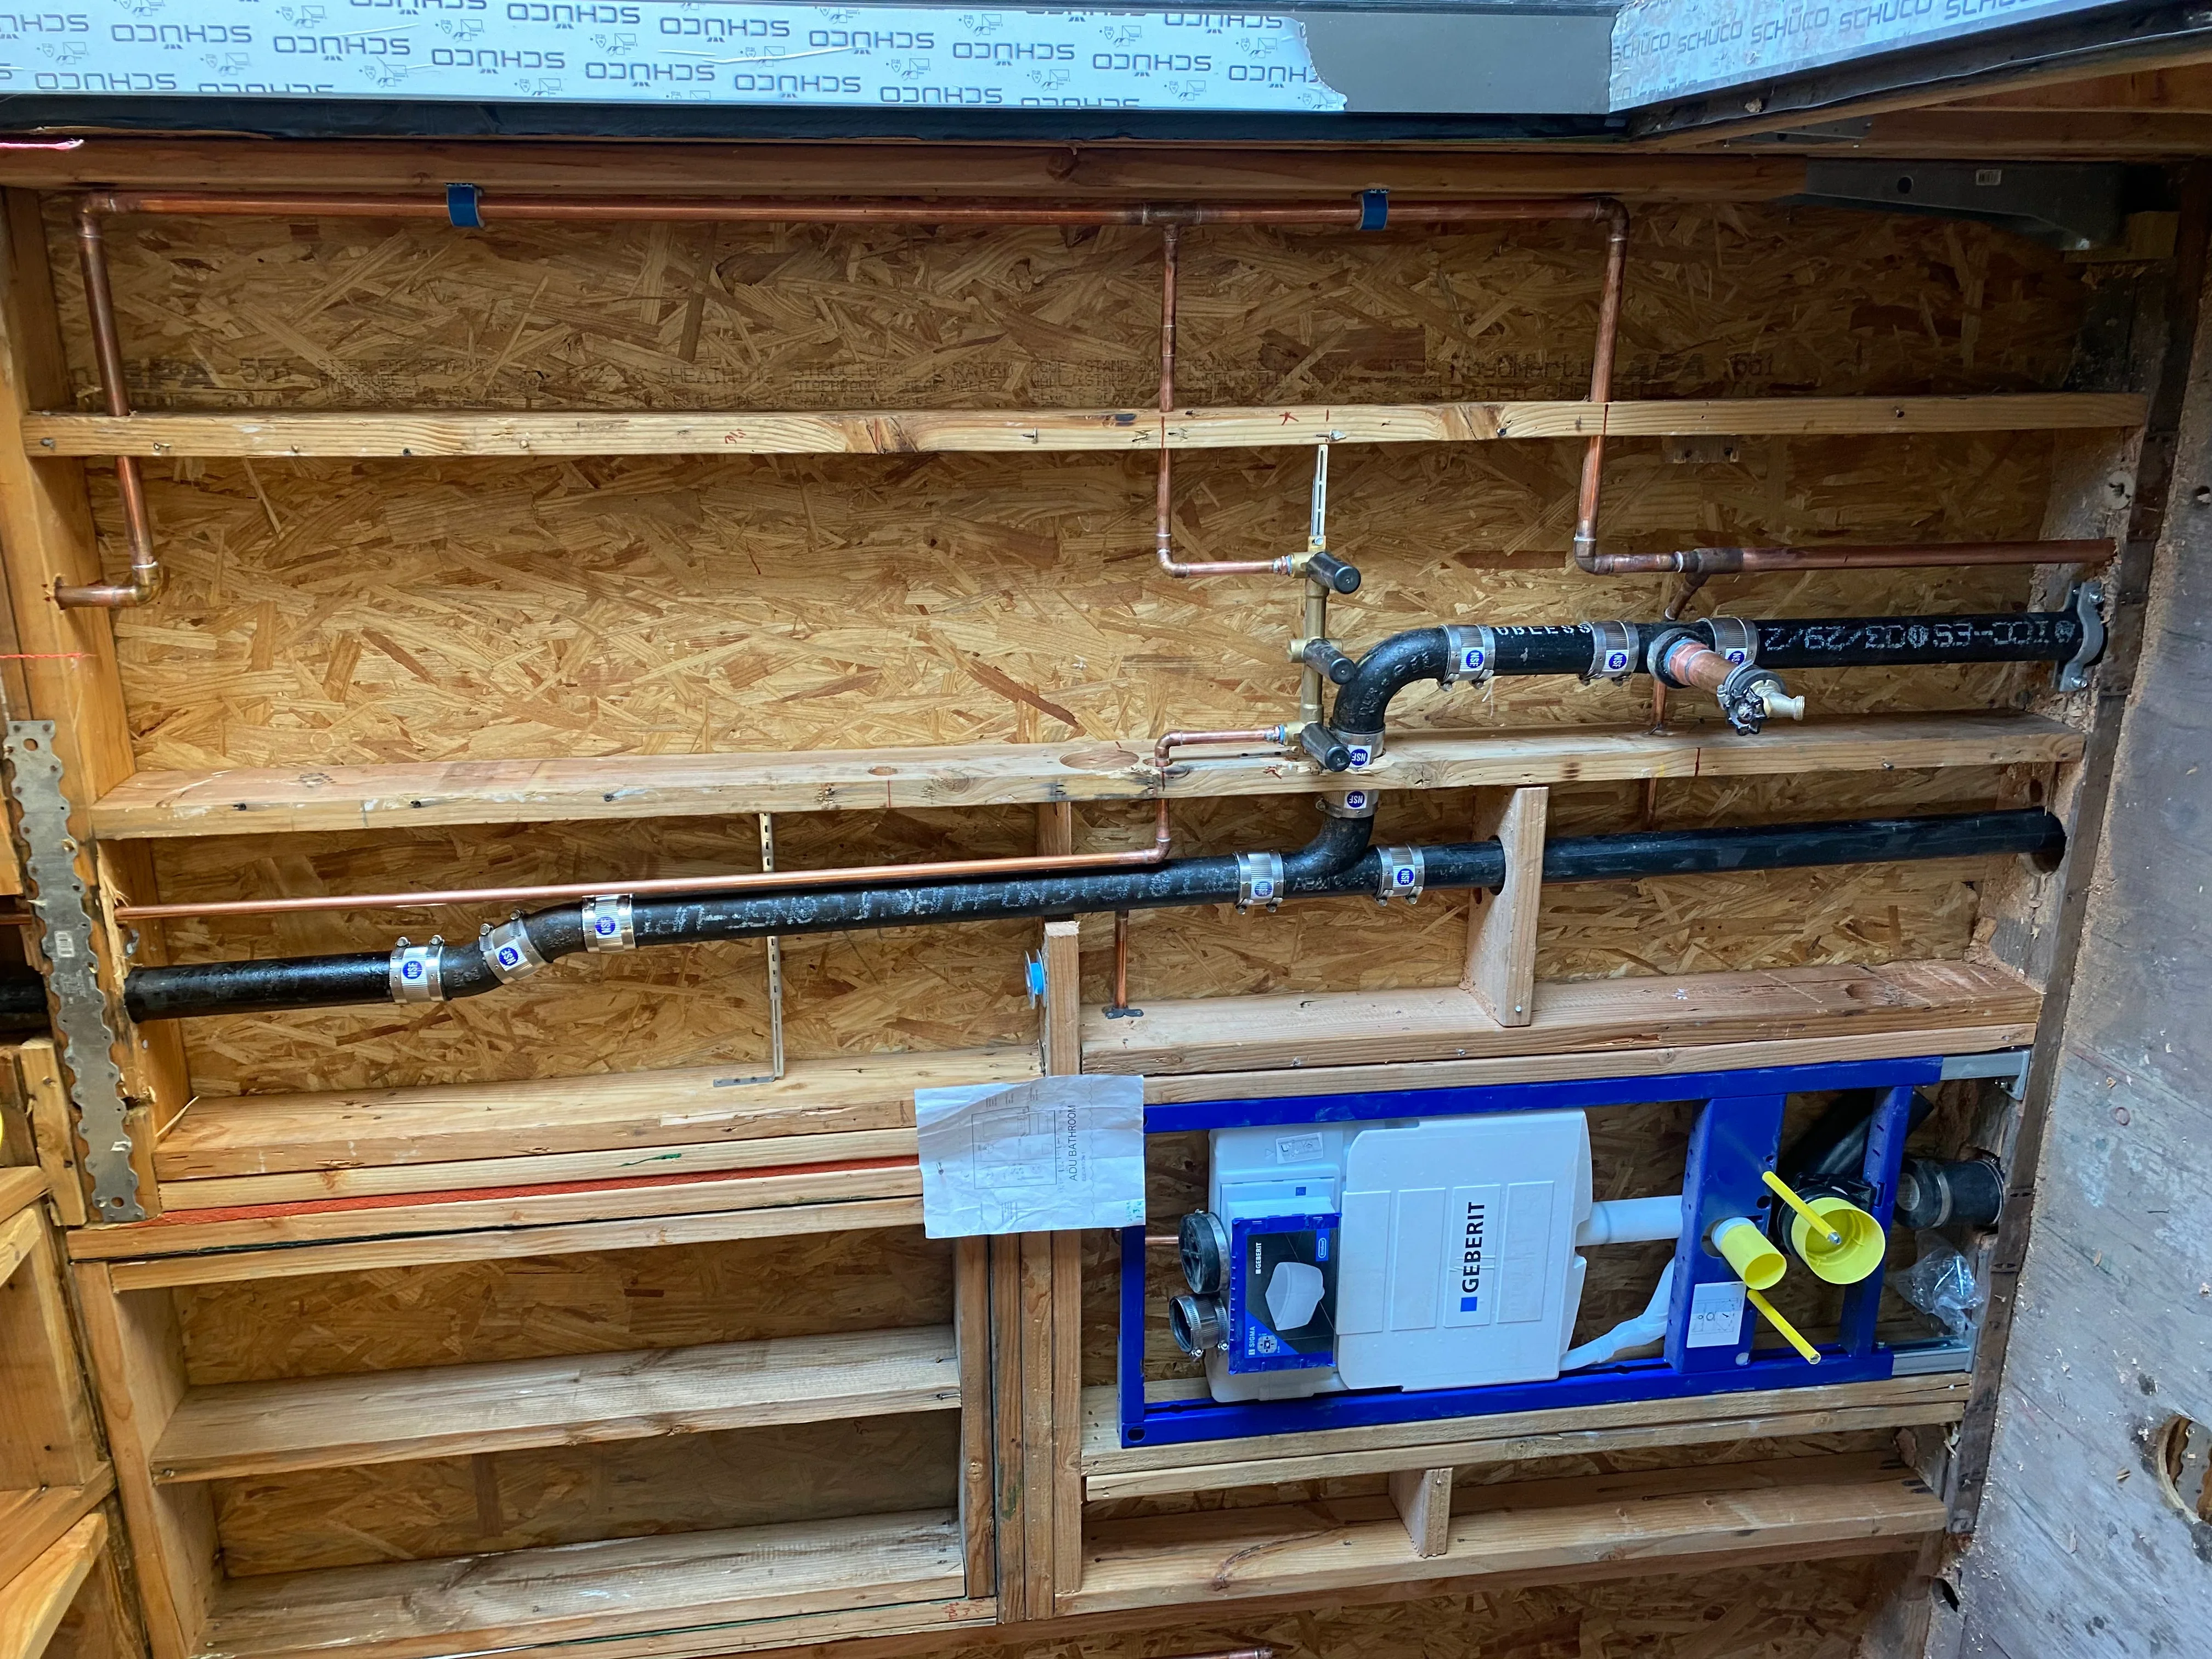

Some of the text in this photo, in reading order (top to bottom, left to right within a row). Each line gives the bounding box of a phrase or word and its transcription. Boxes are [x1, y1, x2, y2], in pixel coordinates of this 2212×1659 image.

[0, 14, 89, 39] SCHÜ
[1068, 1105, 1077, 1181] ADU BATHROOM
[1462, 1201, 1485, 1293] GEBERIT
